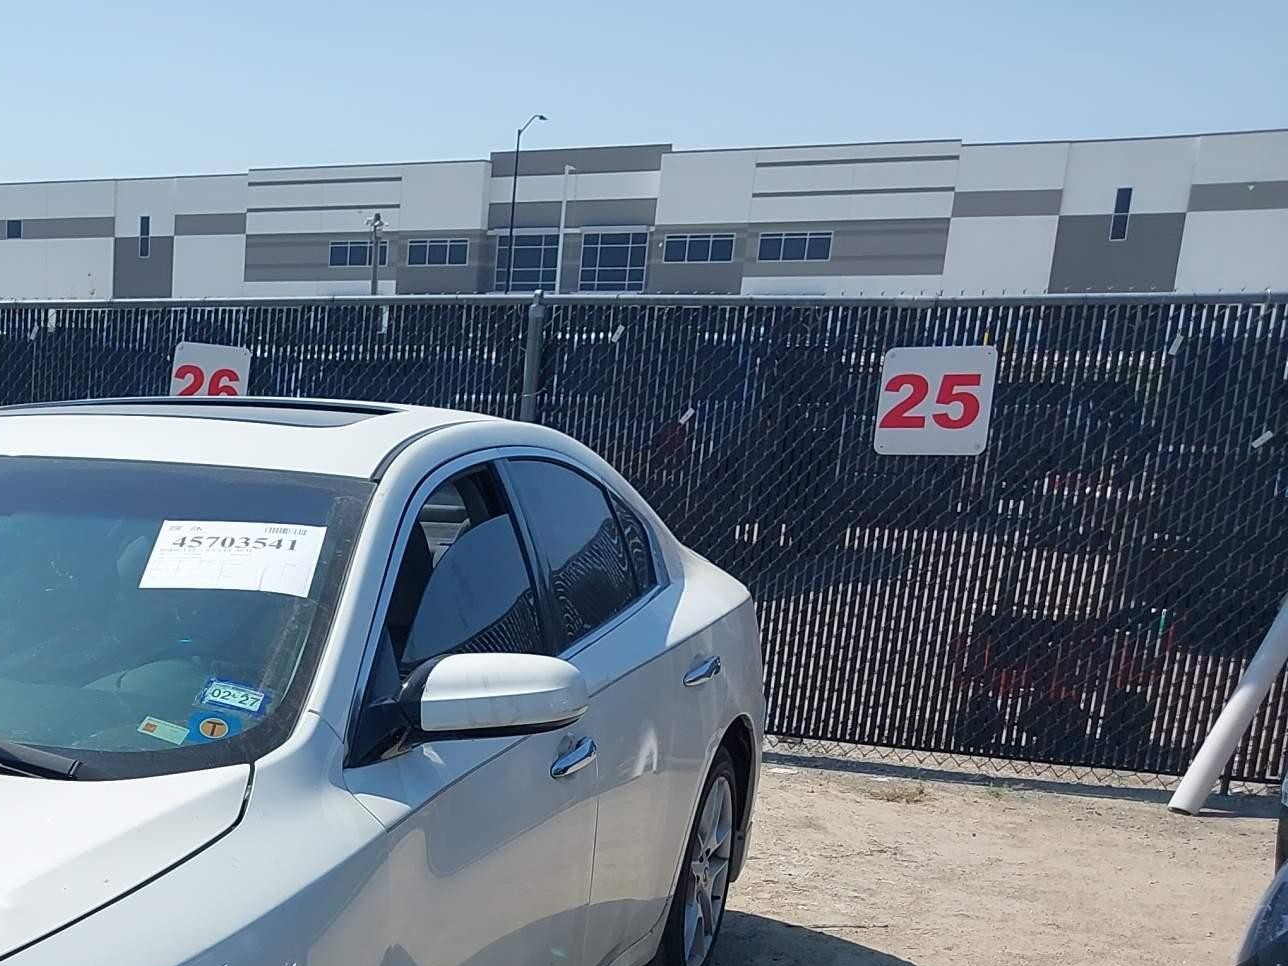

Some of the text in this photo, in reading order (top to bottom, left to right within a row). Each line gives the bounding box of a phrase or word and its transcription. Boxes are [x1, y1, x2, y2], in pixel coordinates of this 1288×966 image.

[174, 364, 240, 397] 26
[878, 373, 982, 430] 25
[171, 535, 298, 552] 45703541
